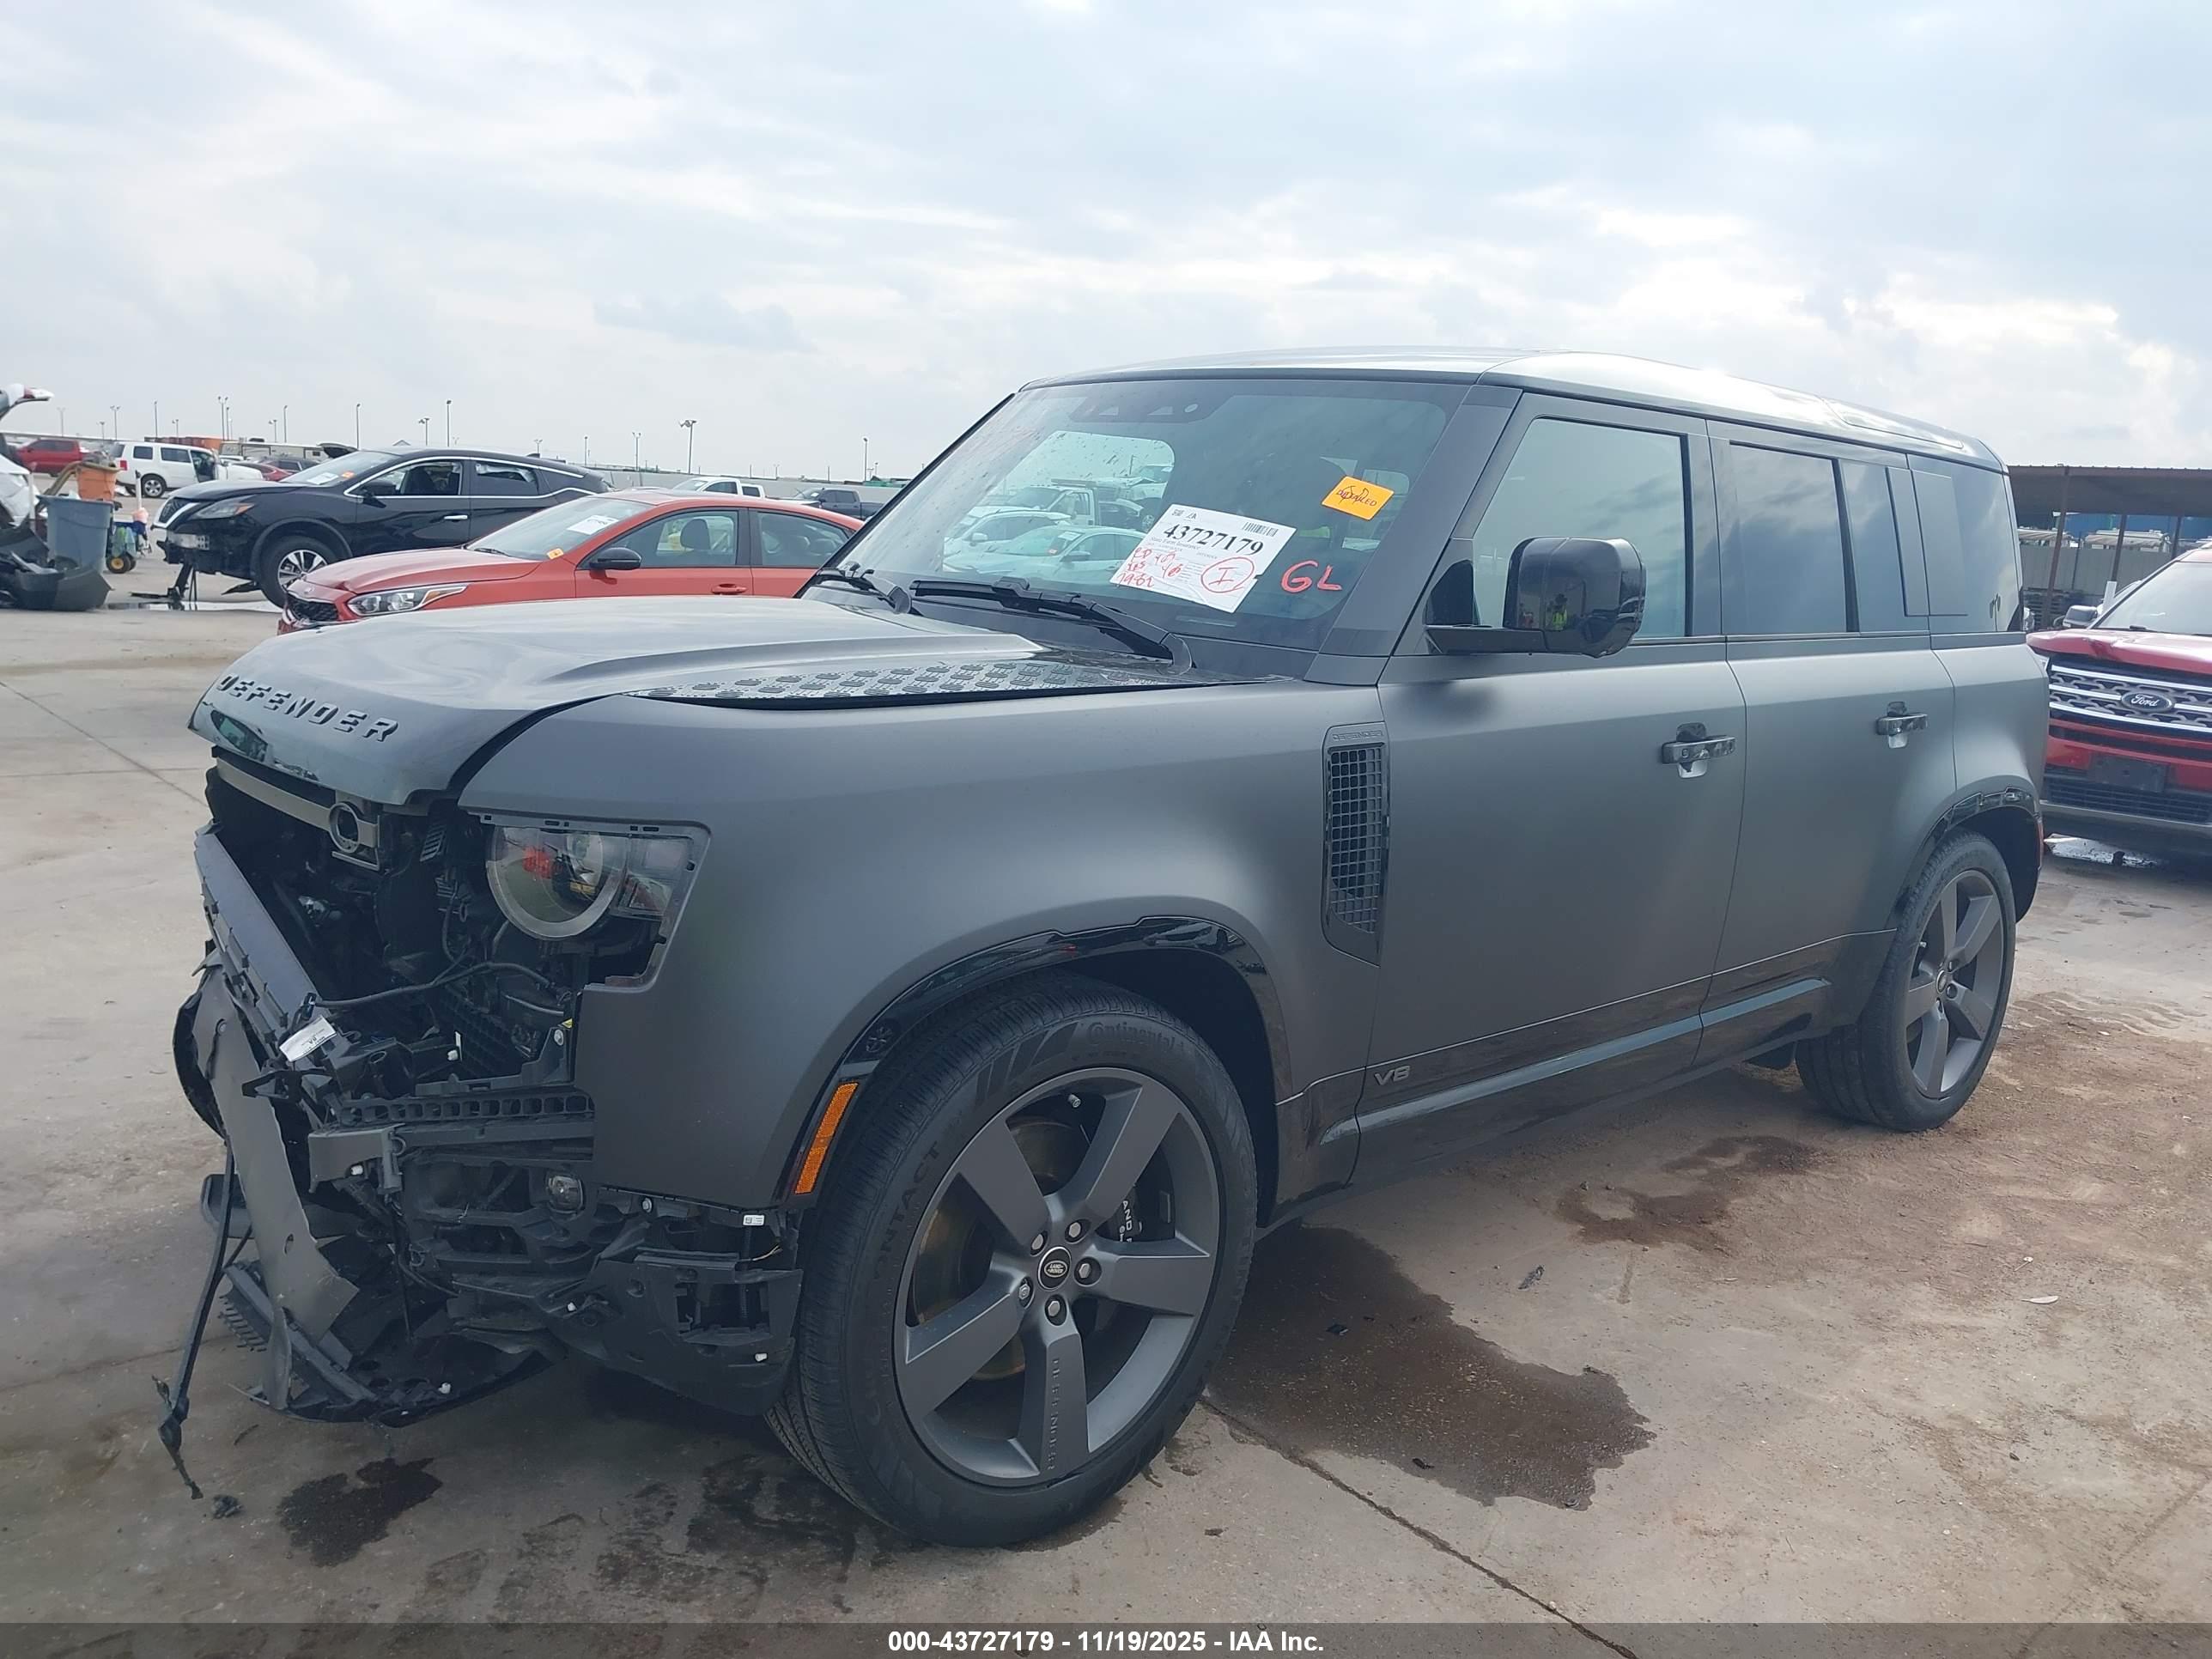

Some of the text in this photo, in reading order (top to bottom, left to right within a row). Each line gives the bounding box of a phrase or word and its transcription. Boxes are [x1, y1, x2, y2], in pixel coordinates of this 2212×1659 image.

[1164, 524, 1264, 555] 43727179
[1280, 560, 1342, 593] GL
[216, 672, 399, 743] DEFENDER
[2130, 694, 2160, 707] Ford
[1374, 1065, 1411, 1085] V8
